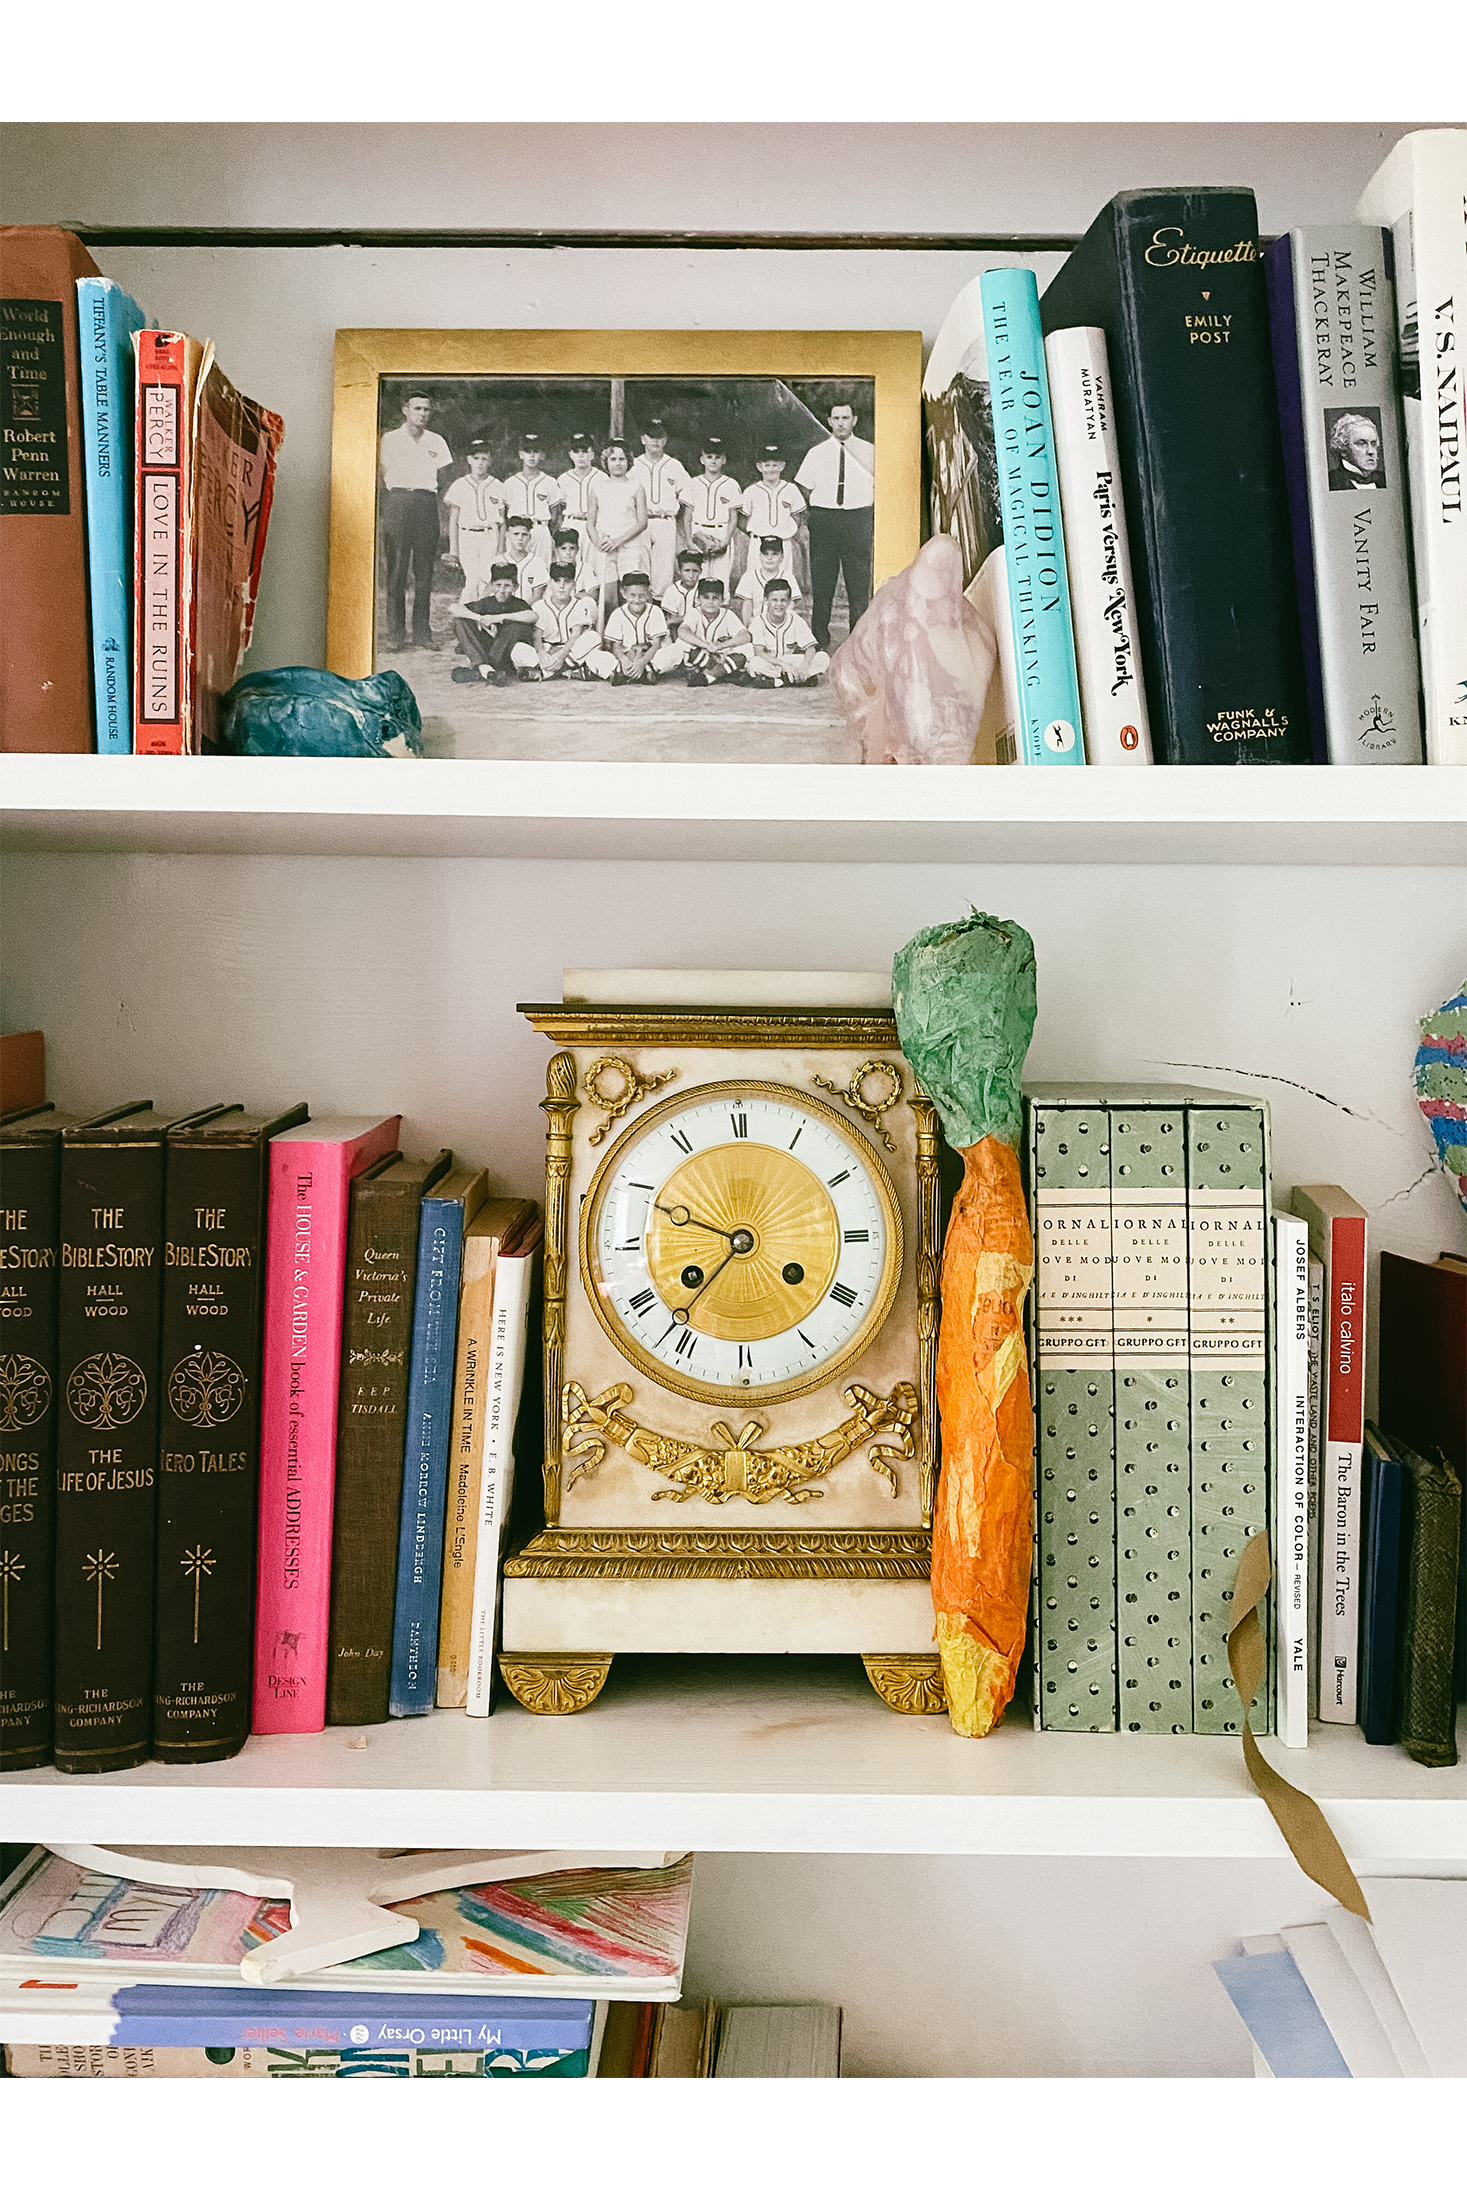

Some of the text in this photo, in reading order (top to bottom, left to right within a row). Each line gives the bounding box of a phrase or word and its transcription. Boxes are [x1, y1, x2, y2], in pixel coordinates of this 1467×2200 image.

[1144, 227, 1257, 269] Etiquette
[1, 307, 49, 323] World
[1185, 314, 1232, 329] EMILY
[1311, 253, 1334, 387] THACKERAY
[1334, 250, 1356, 389] MAKEPEACE
[1358, 268, 1378, 368] WILLIAM
[0, 327, 55, 344] Enough
[1190, 331, 1231, 345] POST
[12, 347, 39, 360] and
[6, 365, 47, 380] Time
[93, 297, 111, 478] TIFFANY'S TABLE MANNERS
[1080, 368, 1096, 440] MURATYAN
[1095, 375, 1107, 432] VAHRAM
[1434, 295, 1461, 524] V. S. NAIPAUL
[3, 428, 56, 443] Robert
[149, 392, 164, 459] PERCY
[164, 398, 173, 453] WALKER
[11, 447, 49, 461] Penn
[2, 467, 60, 481] Warren
[992, 301, 1041, 688] THE YEAR OF MAGICAL THINKING
[1020, 368, 1061, 615] JOAN DIDION
[1093, 470, 1115, 519] Paris
[1101, 523, 1119, 584] versus
[1353, 507, 1379, 655] VANITY FAIR
[151, 483, 169, 713] LOVE IN THE RUINS
[105, 657, 118, 740] RANDOM HOUSE
[1206, 715, 1289, 733] WAGNALLS
[1217, 707, 1276, 720] FUNK &
[1358, 706, 1395, 721] MODERN
[1213, 727, 1287, 743] COMPANY
[1361, 738, 1397, 750] LIBRARY
[91, 1208, 124, 1229] THE
[194, 1208, 226, 1230] THE
[364, 1248, 400, 1264] Queen
[355, 1269, 408, 1283] Victoria's
[86, 1285, 123, 1296] HALL
[188, 1284, 224, 1295] HALL
[358, 1291, 401, 1303] Private
[428, 1269, 443, 1316] FROM
[1295, 1239, 1305, 1340] JOSEF ALBERS
[84, 1305, 128, 1317] WOOD
[186, 1304, 229, 1316] WOOD
[366, 1312, 390, 1328] Life
[1311, 1309, 1320, 1341] ELIOT
[1339, 1281, 1356, 1374] italo calvino
[1038, 1338, 1106, 1347] GRUPPO GFT
[1117, 1338, 1187, 1347] GRUPPO GFT
[1193, 1340, 1263, 1348] GRUPPO GFT
[284, 1171, 312, 1590] The HOUSE & GARDEN book of essential ADDRESSES
[1310, 1371, 1318, 1402] WASTE
[460, 1337, 478, 1454] A WRINKLE IN TIME
[351, 1404, 398, 1414] TISDALL
[485, 1309, 506, 1526] HERE IS NEW YORK E. B. WHITE
[1309, 1404, 1317, 1430] LAND
[1295, 1395, 1305, 1486] INTERACTION
[1309, 1433, 1317, 1454] AND
[88, 1449, 122, 1464] THE
[198, 1450, 247, 1473] TALES
[57, 1467, 154, 1492] LIFE OF JESUS
[1295, 1492, 1304, 1510] OF
[1308, 1491, 1316, 1519] POEMS
[453, 1463, 470, 1570] Madeleine L'Engle
[1294, 1515, 1304, 1561] COLOR
[1335, 1452, 1352, 1616] The Baron in the Trees
[478, 1628, 486, 1653] LITTLE
[337, 1647, 384, 1659] John Day
[407, 1621, 421, 1690] PANTHEON
[1293, 1638, 1303, 1672] YALE
[180, 1682, 204, 1692] THE
[268, 1675, 307, 1686] DESIGN
[475, 1655, 484, 1700] BOOKROOM
[1336, 1669, 1344, 1706] Harcourt
[84, 1689, 109, 1699] THE
[274, 1688, 300, 1699] LINE
[69, 1714, 123, 1727] COMPANY
[167, 1708, 217, 1719] COMPANY
[240, 2024, 501, 2045] My Little Orsay Marie Sellier
